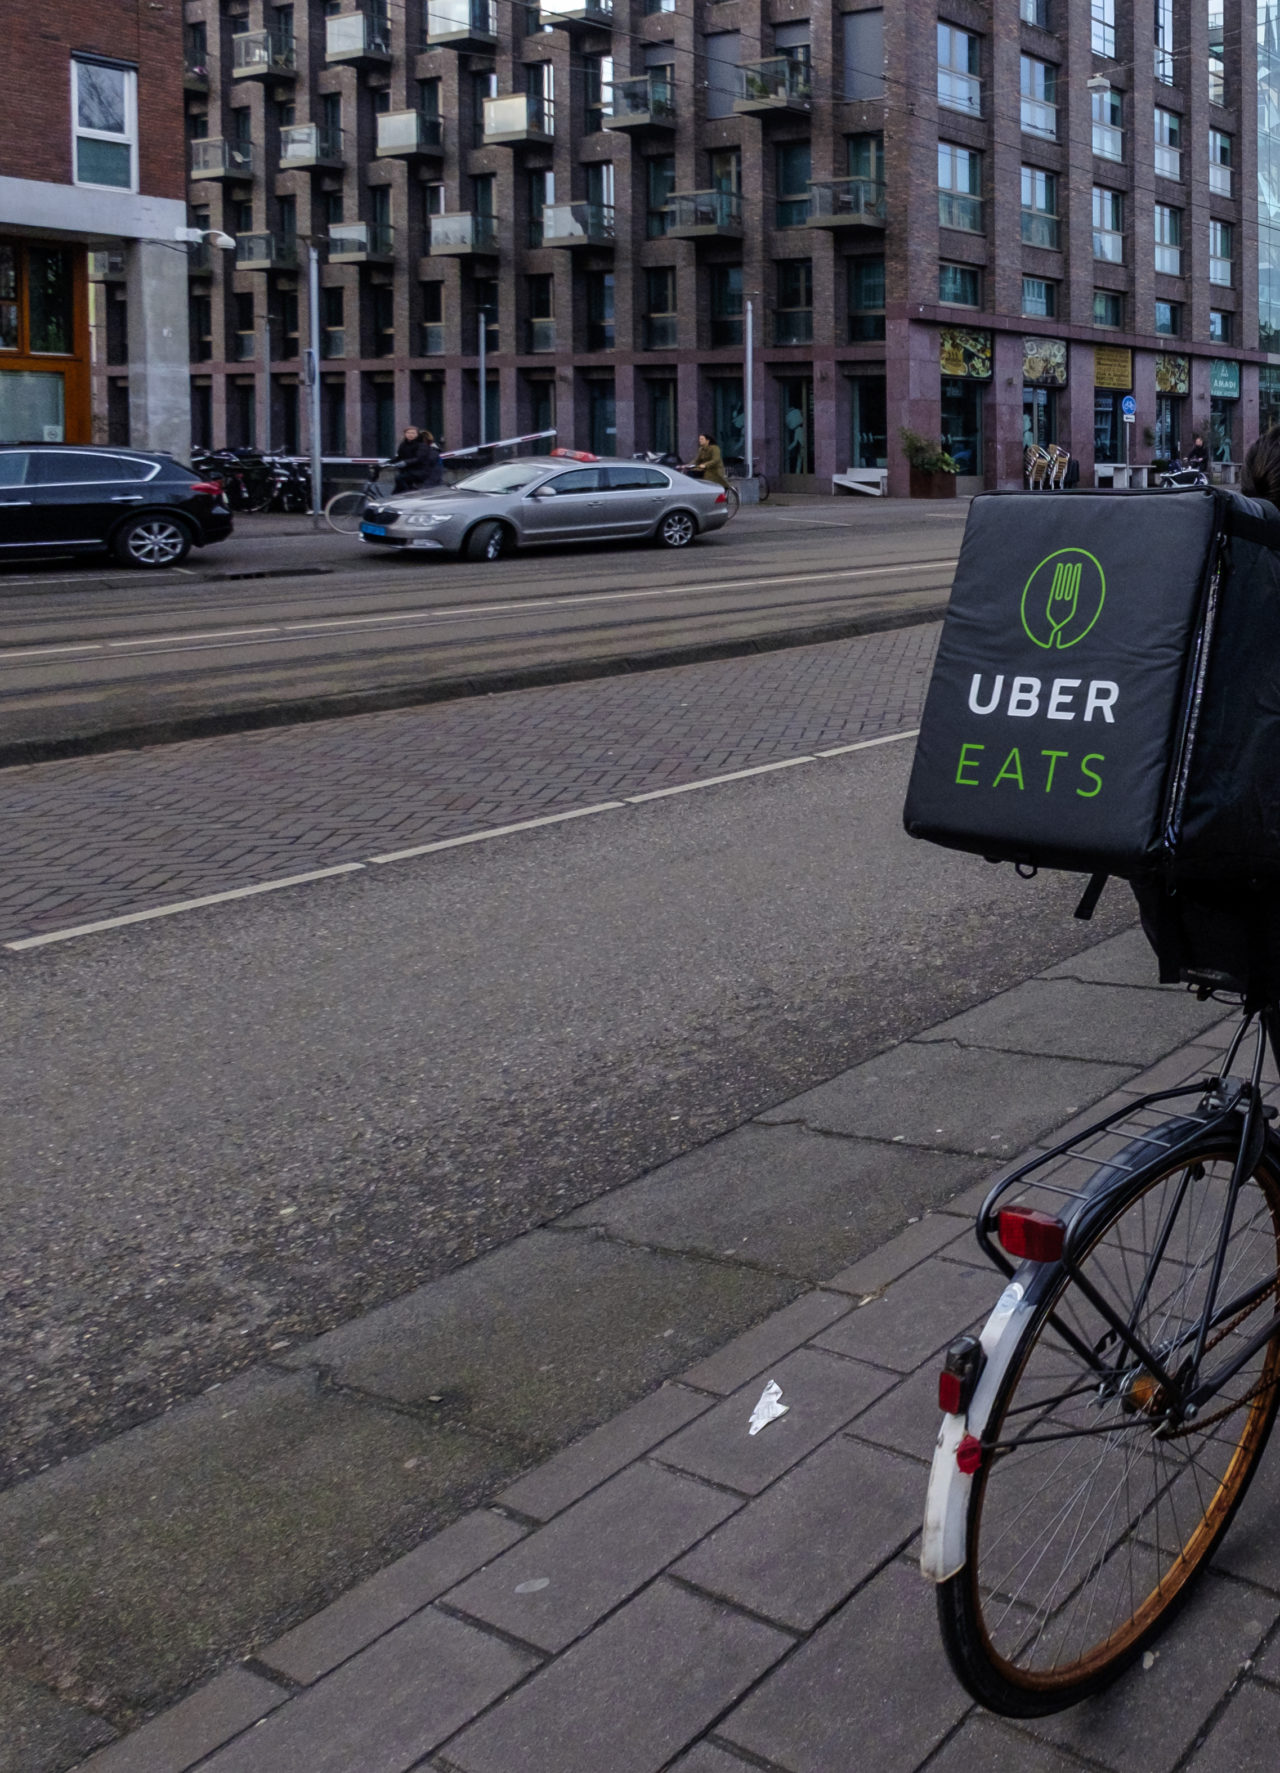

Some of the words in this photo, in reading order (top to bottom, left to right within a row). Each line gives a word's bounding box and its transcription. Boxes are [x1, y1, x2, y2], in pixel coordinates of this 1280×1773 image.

[1213, 379, 1236, 389] AMADI
[968, 673, 1119, 723] UBER
[955, 743, 1105, 798] EATS
